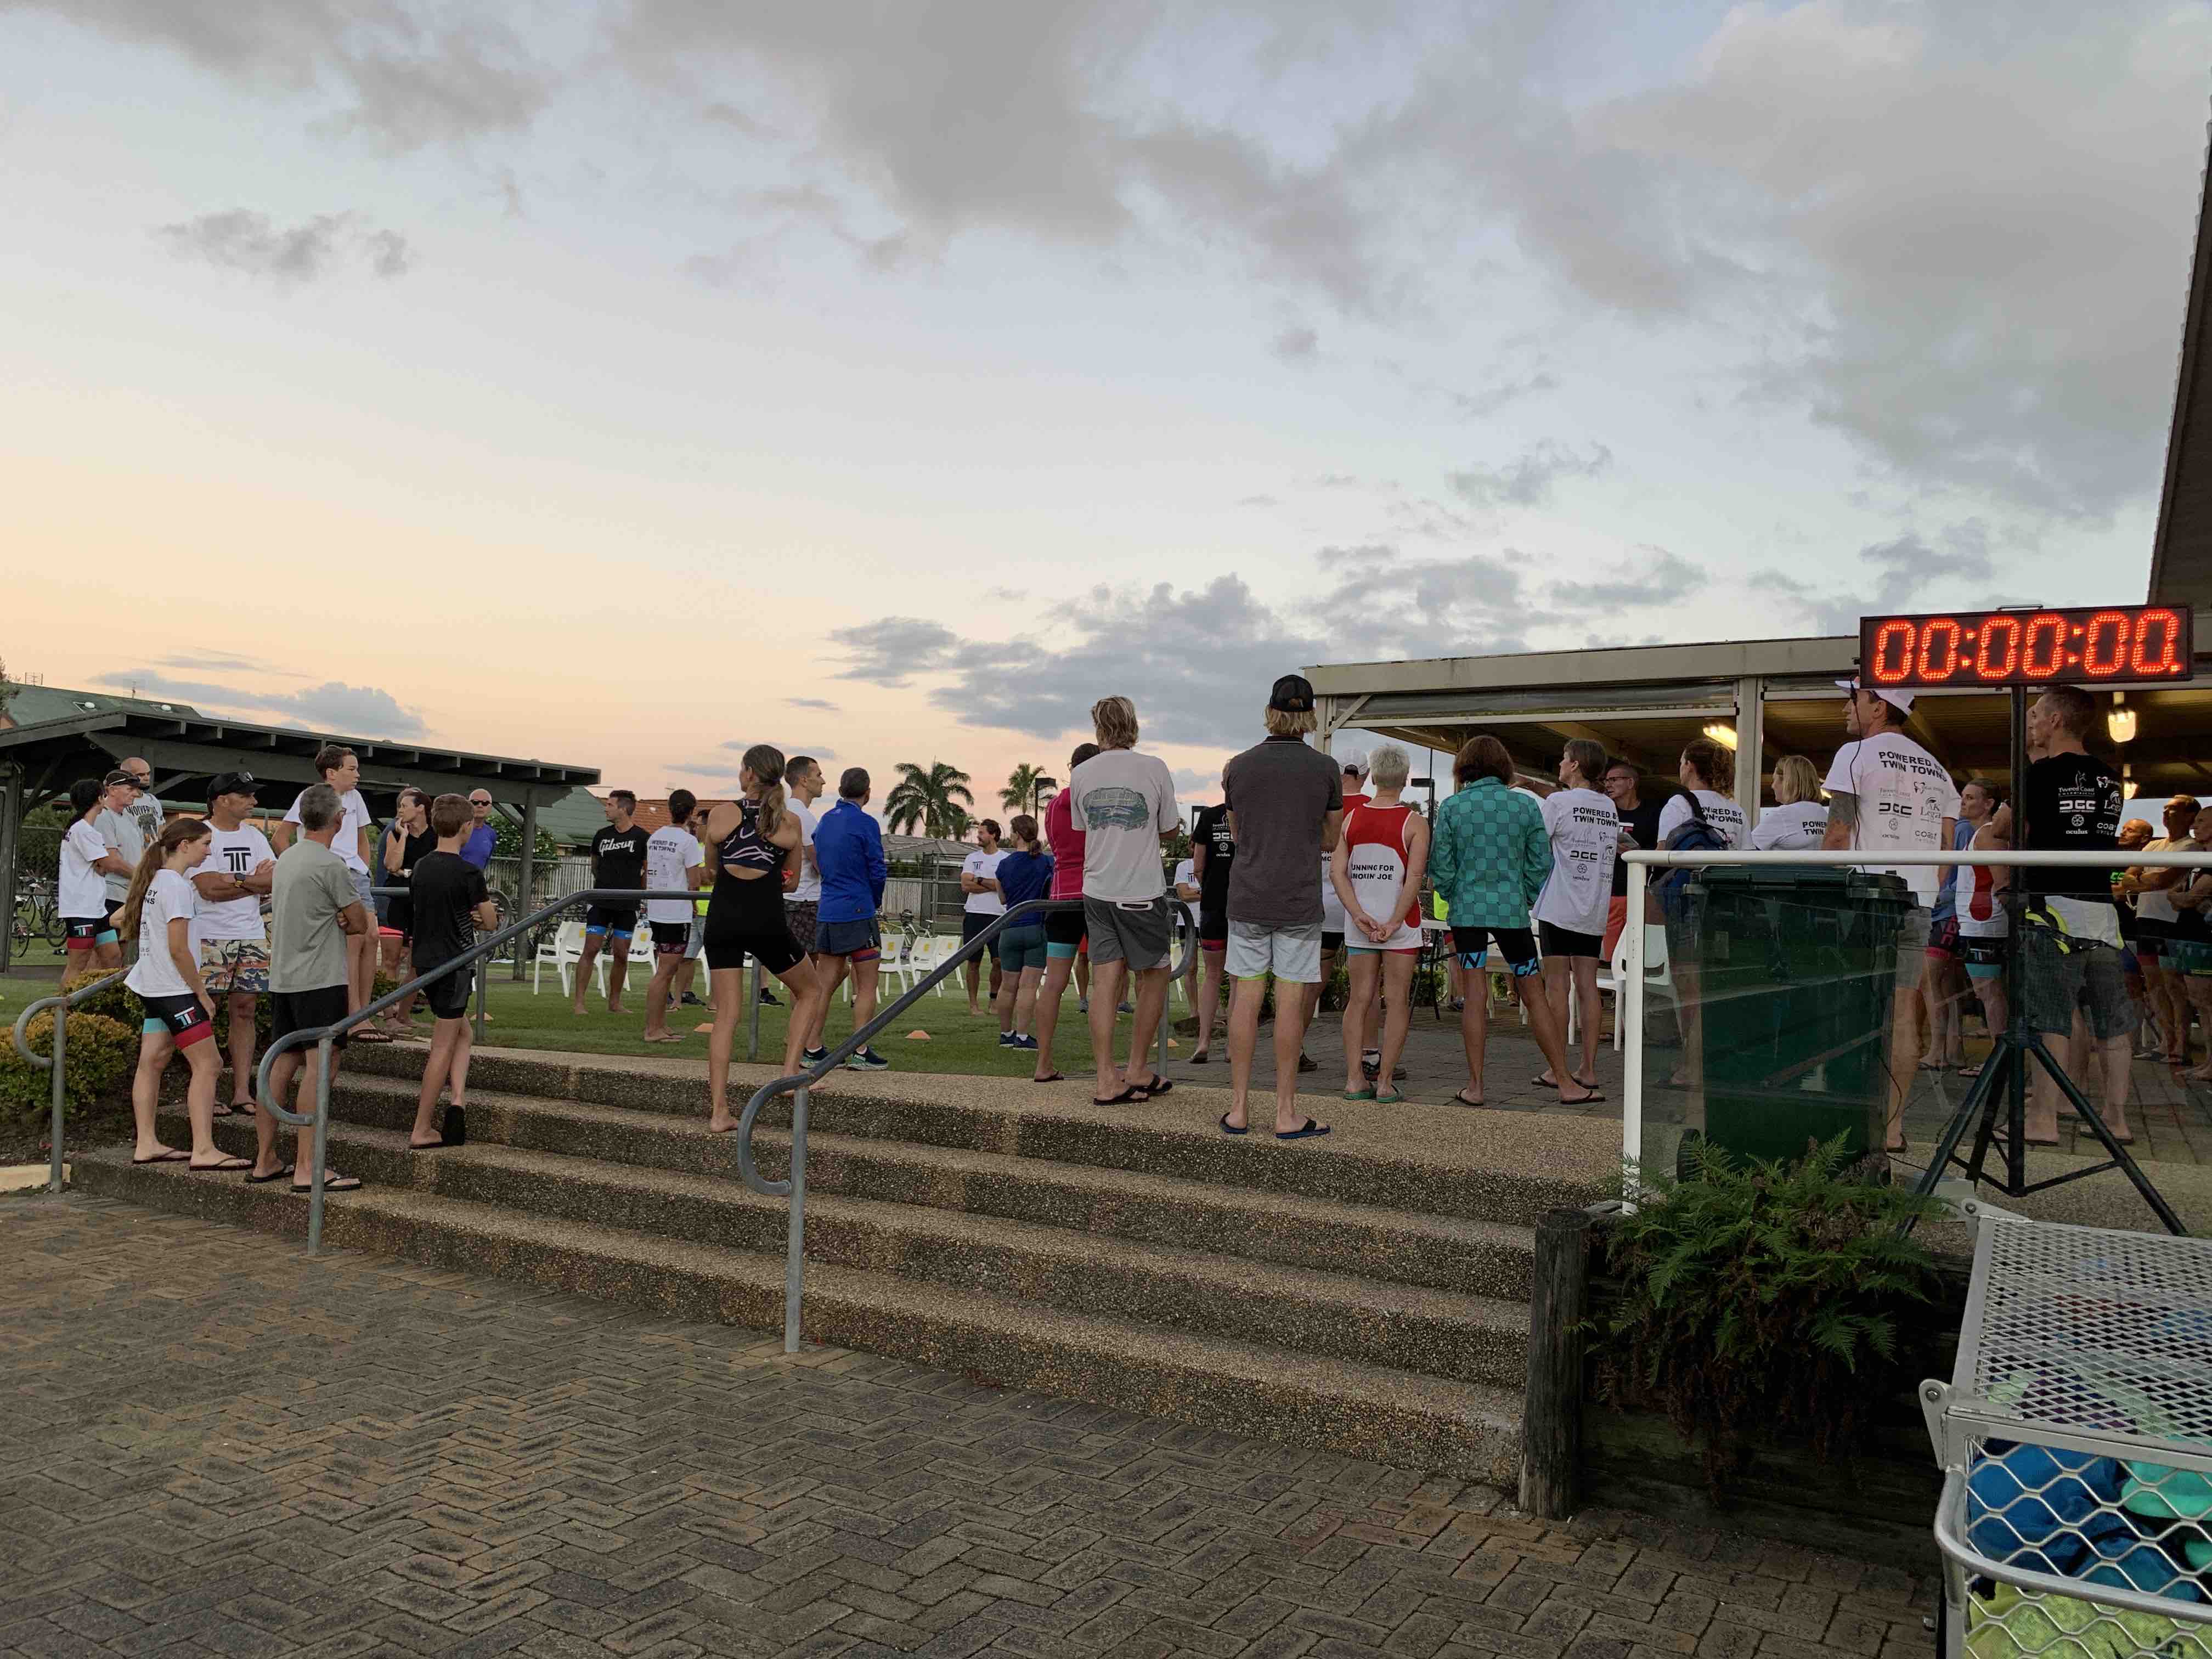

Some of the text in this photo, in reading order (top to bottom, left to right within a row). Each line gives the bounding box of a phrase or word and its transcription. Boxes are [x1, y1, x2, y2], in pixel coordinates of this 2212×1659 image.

[1879, 751, 1931, 766] POWERED
[1881, 760, 1947, 782] TWIN TOWNS
[1572, 807, 1611, 819] POWERED
[1573, 815, 1618, 828] TWIN TOWN
[599, 838, 635, 857] Gibson
